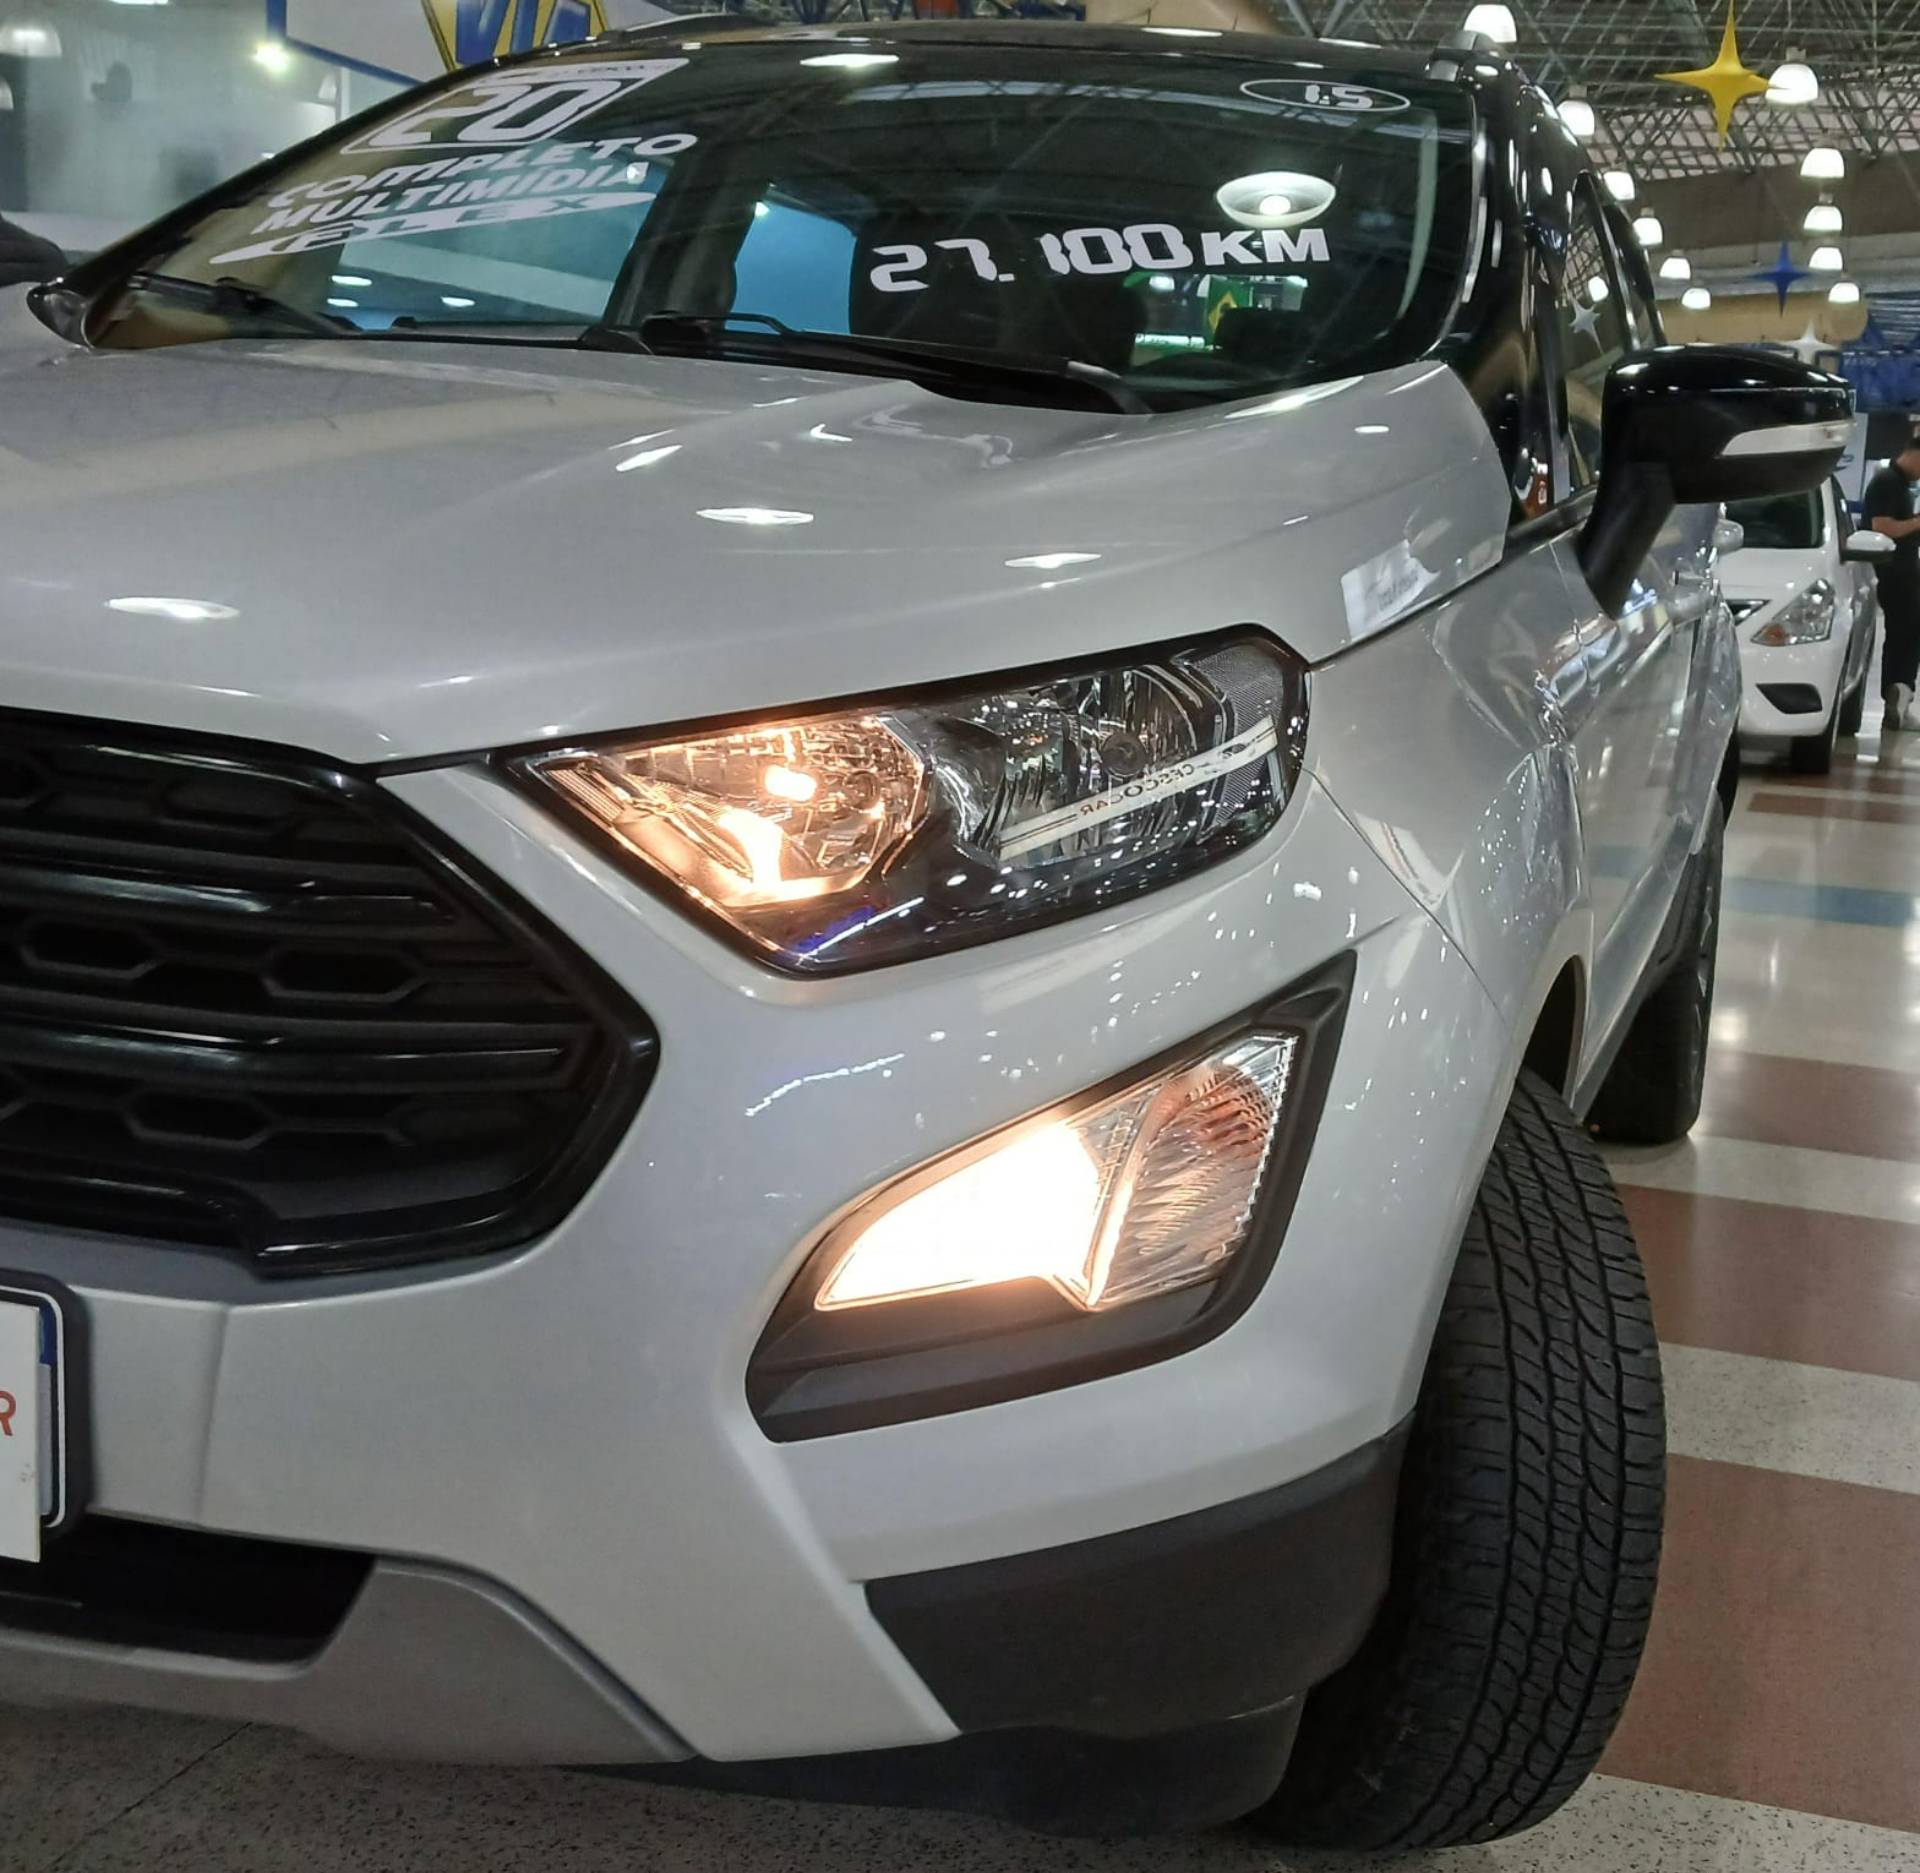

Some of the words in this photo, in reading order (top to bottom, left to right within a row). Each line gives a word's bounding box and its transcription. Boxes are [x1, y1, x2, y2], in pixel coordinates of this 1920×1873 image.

[368, 78, 621, 145] 20
[1305, 84, 1374, 109] 1.5
[268, 133, 698, 208] COMPLETO
[271, 196, 590, 252] FLEX
